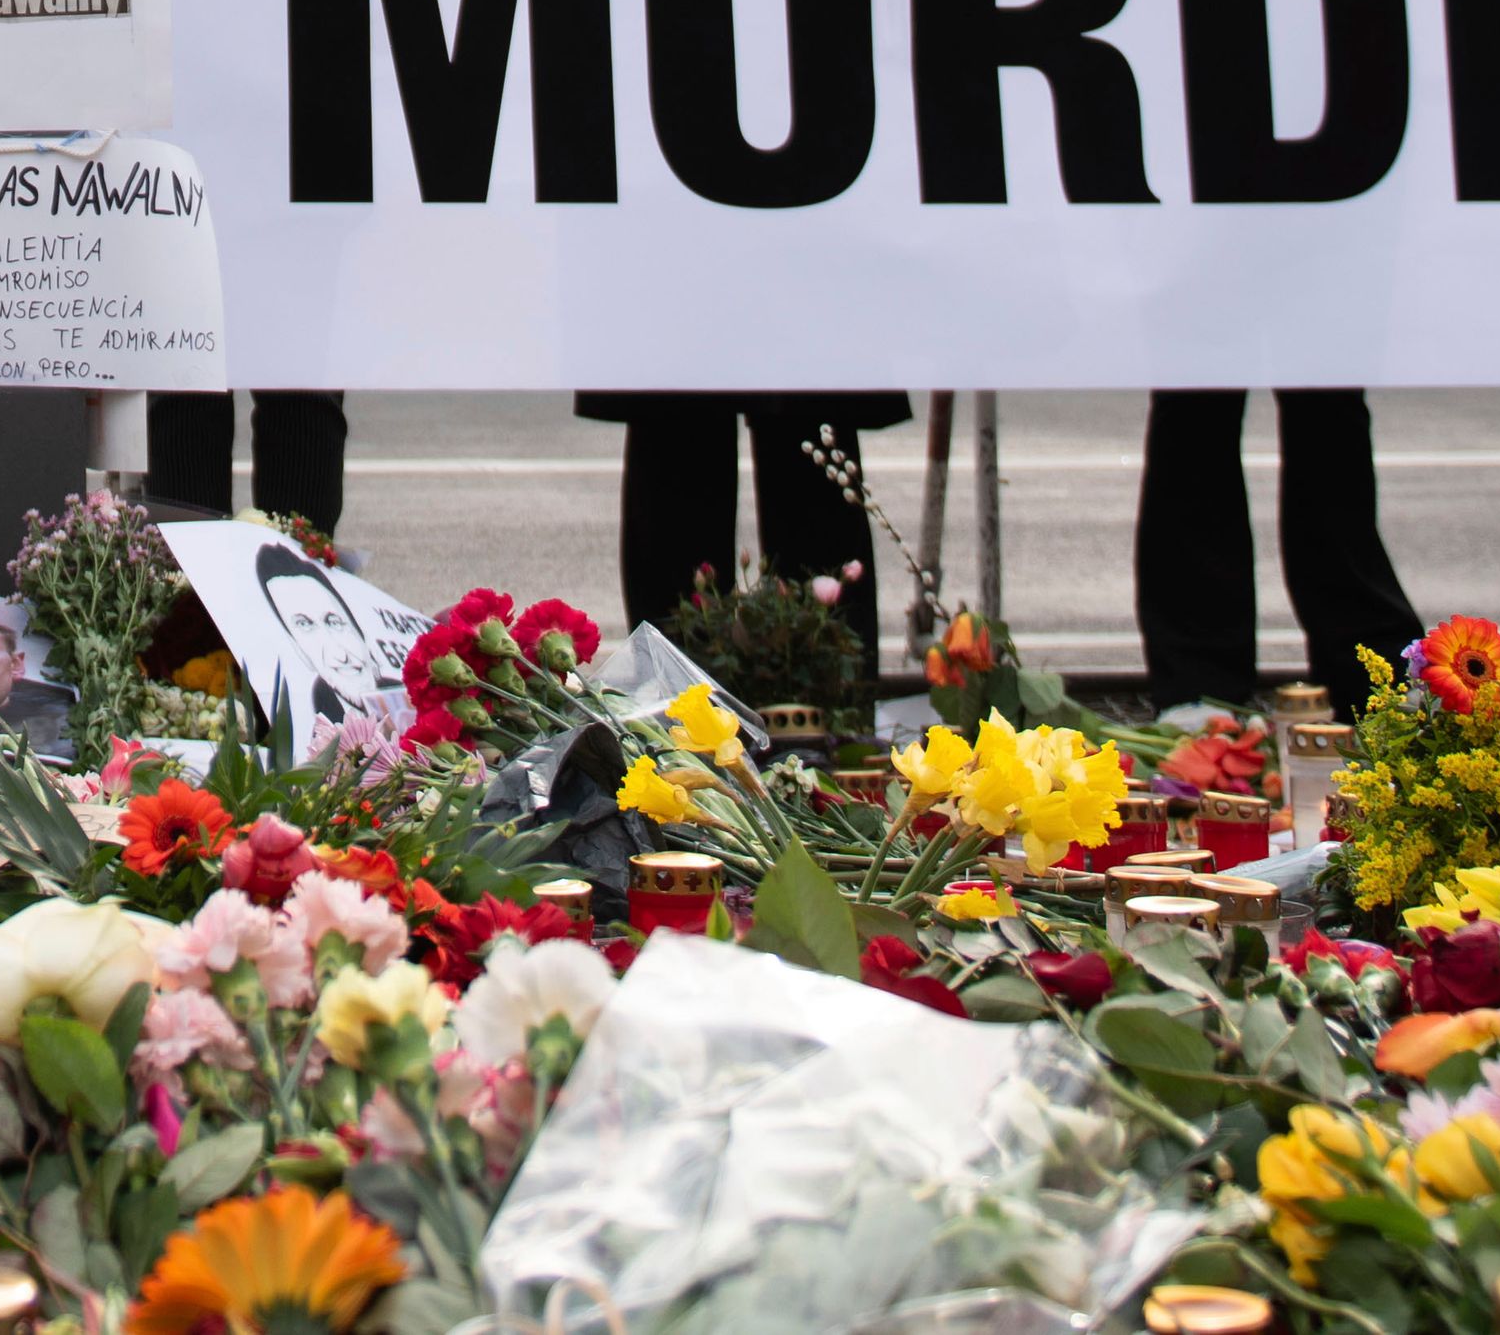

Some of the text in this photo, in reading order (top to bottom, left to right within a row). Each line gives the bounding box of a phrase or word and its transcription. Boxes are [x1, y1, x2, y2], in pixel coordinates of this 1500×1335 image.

[50, 160, 203, 227] NAWALNY
[53, 327, 84, 349] TE
[99, 328, 215, 352] ADMIRAMOS
